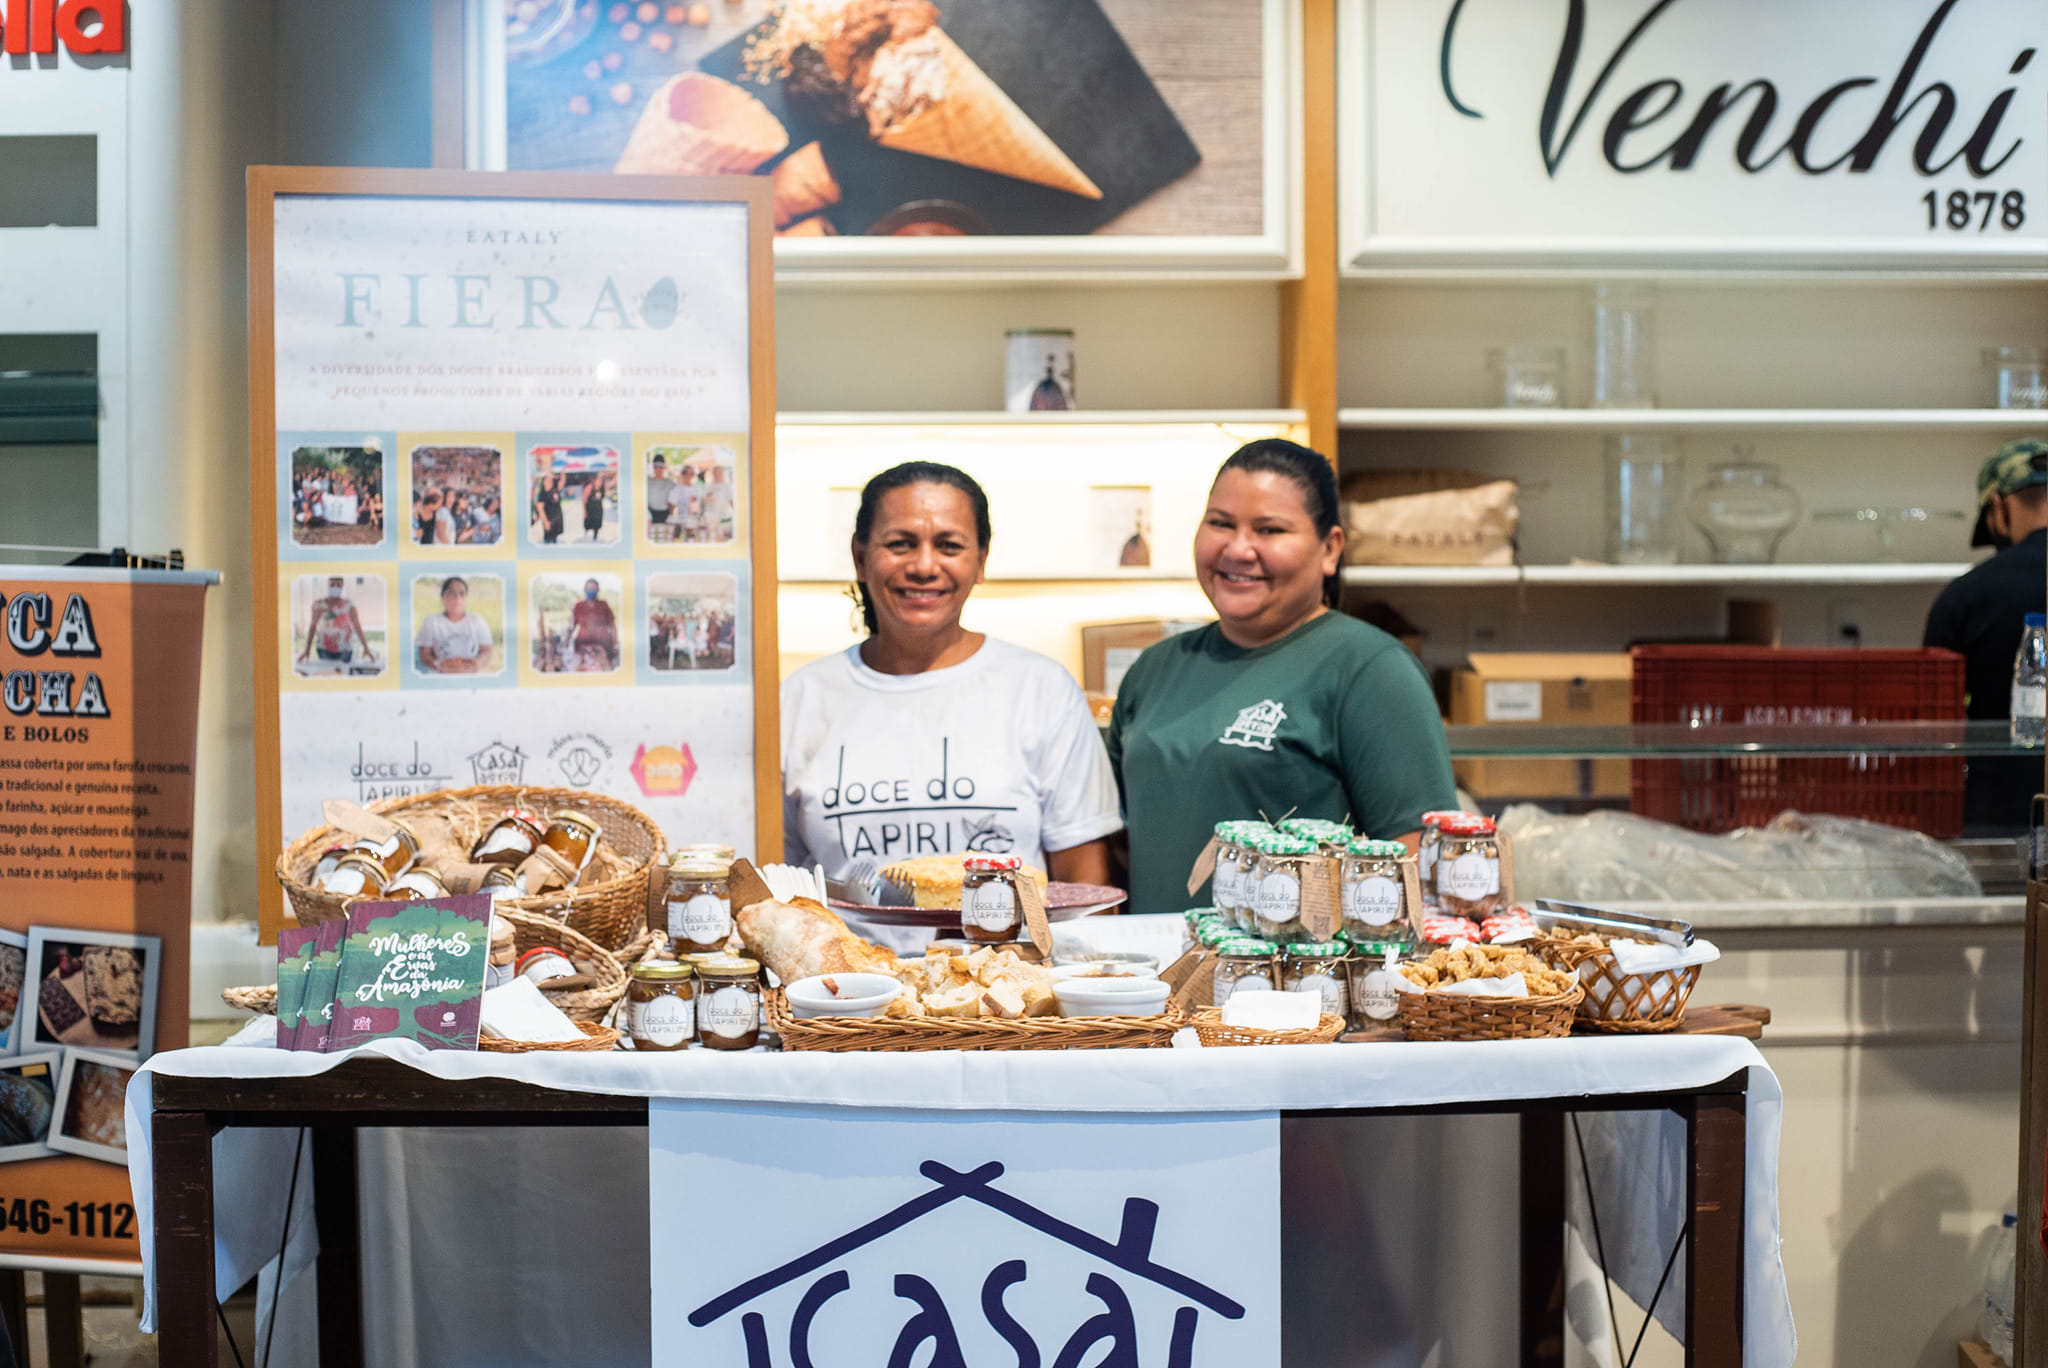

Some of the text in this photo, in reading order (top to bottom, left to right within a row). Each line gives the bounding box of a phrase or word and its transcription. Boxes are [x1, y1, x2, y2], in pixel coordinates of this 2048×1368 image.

[0, 0, 124, 54] lla
[1441, 0, 2037, 178] Venchi
[1922, 190, 2026, 231] 1878
[466, 230, 562, 245] EATALY
[335, 272, 641, 330] FIERA
[0, 592, 101, 658] CA
[0, 670, 110, 718] CHA
[4, 726, 89, 743] E BOLOS
[24, 756, 64, 771] coberta
[67, 760, 84, 774] por
[86, 761, 110, 772] uma
[113, 760, 145, 773] farofa
[406, 740, 433, 776] do
[927, 736, 975, 801] do
[6, 779, 63, 792] tradicional
[66, 783, 72, 791] e
[87, 805, 93, 815] e
[30, 821, 49, 835] dos
[51, 824, 119, 840] apreciadores
[121, 825, 135, 837] da
[832, 812, 951, 859] TAPIRI
[68, 846, 75, 856] A
[79, 846, 131, 860] cobertura
[7, 866, 31, 879] nata
[33, 870, 40, 879] e
[42, 870, 54, 880] as
[57, 866, 103, 883] salgadas
[105, 867, 118, 881] de
[368, 931, 472, 957] Mulheres
[382, 953, 437, 981] Ervas
[409, 969, 428, 980] da
[355, 973, 465, 1002] Amazônia
